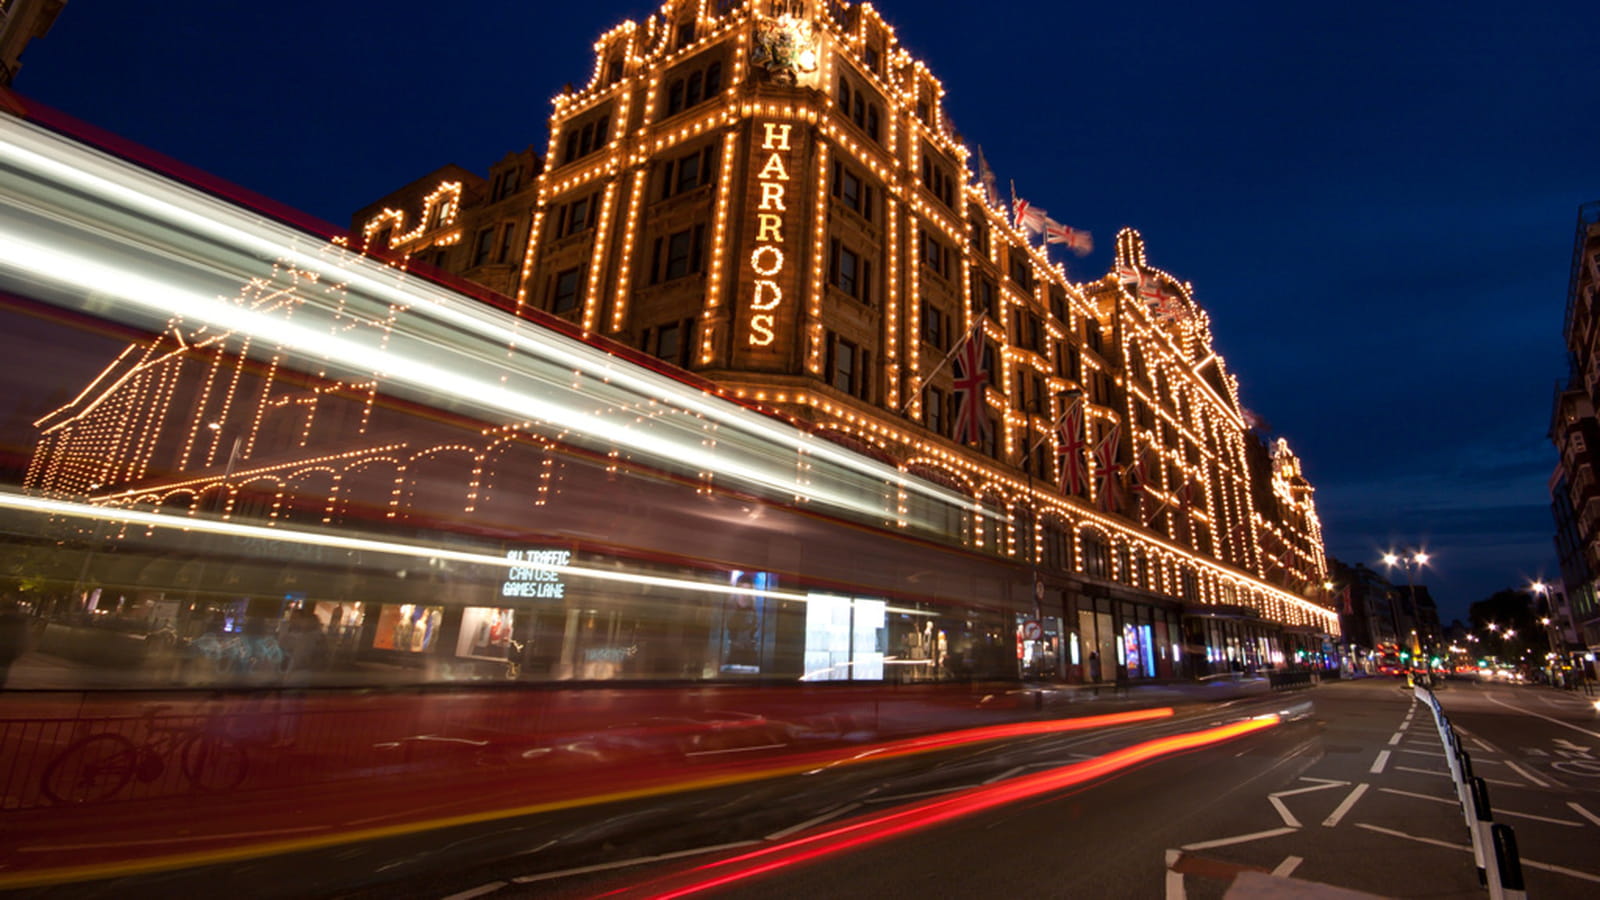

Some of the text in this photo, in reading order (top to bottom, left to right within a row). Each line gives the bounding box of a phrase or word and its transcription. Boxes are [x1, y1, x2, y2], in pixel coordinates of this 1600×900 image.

[749, 123, 791, 346] HARRODS
[506, 550, 571, 565] ALL TRAFFIC
[509, 566, 559, 581] CAN USE
[503, 581, 564, 599] GAMES LANE
